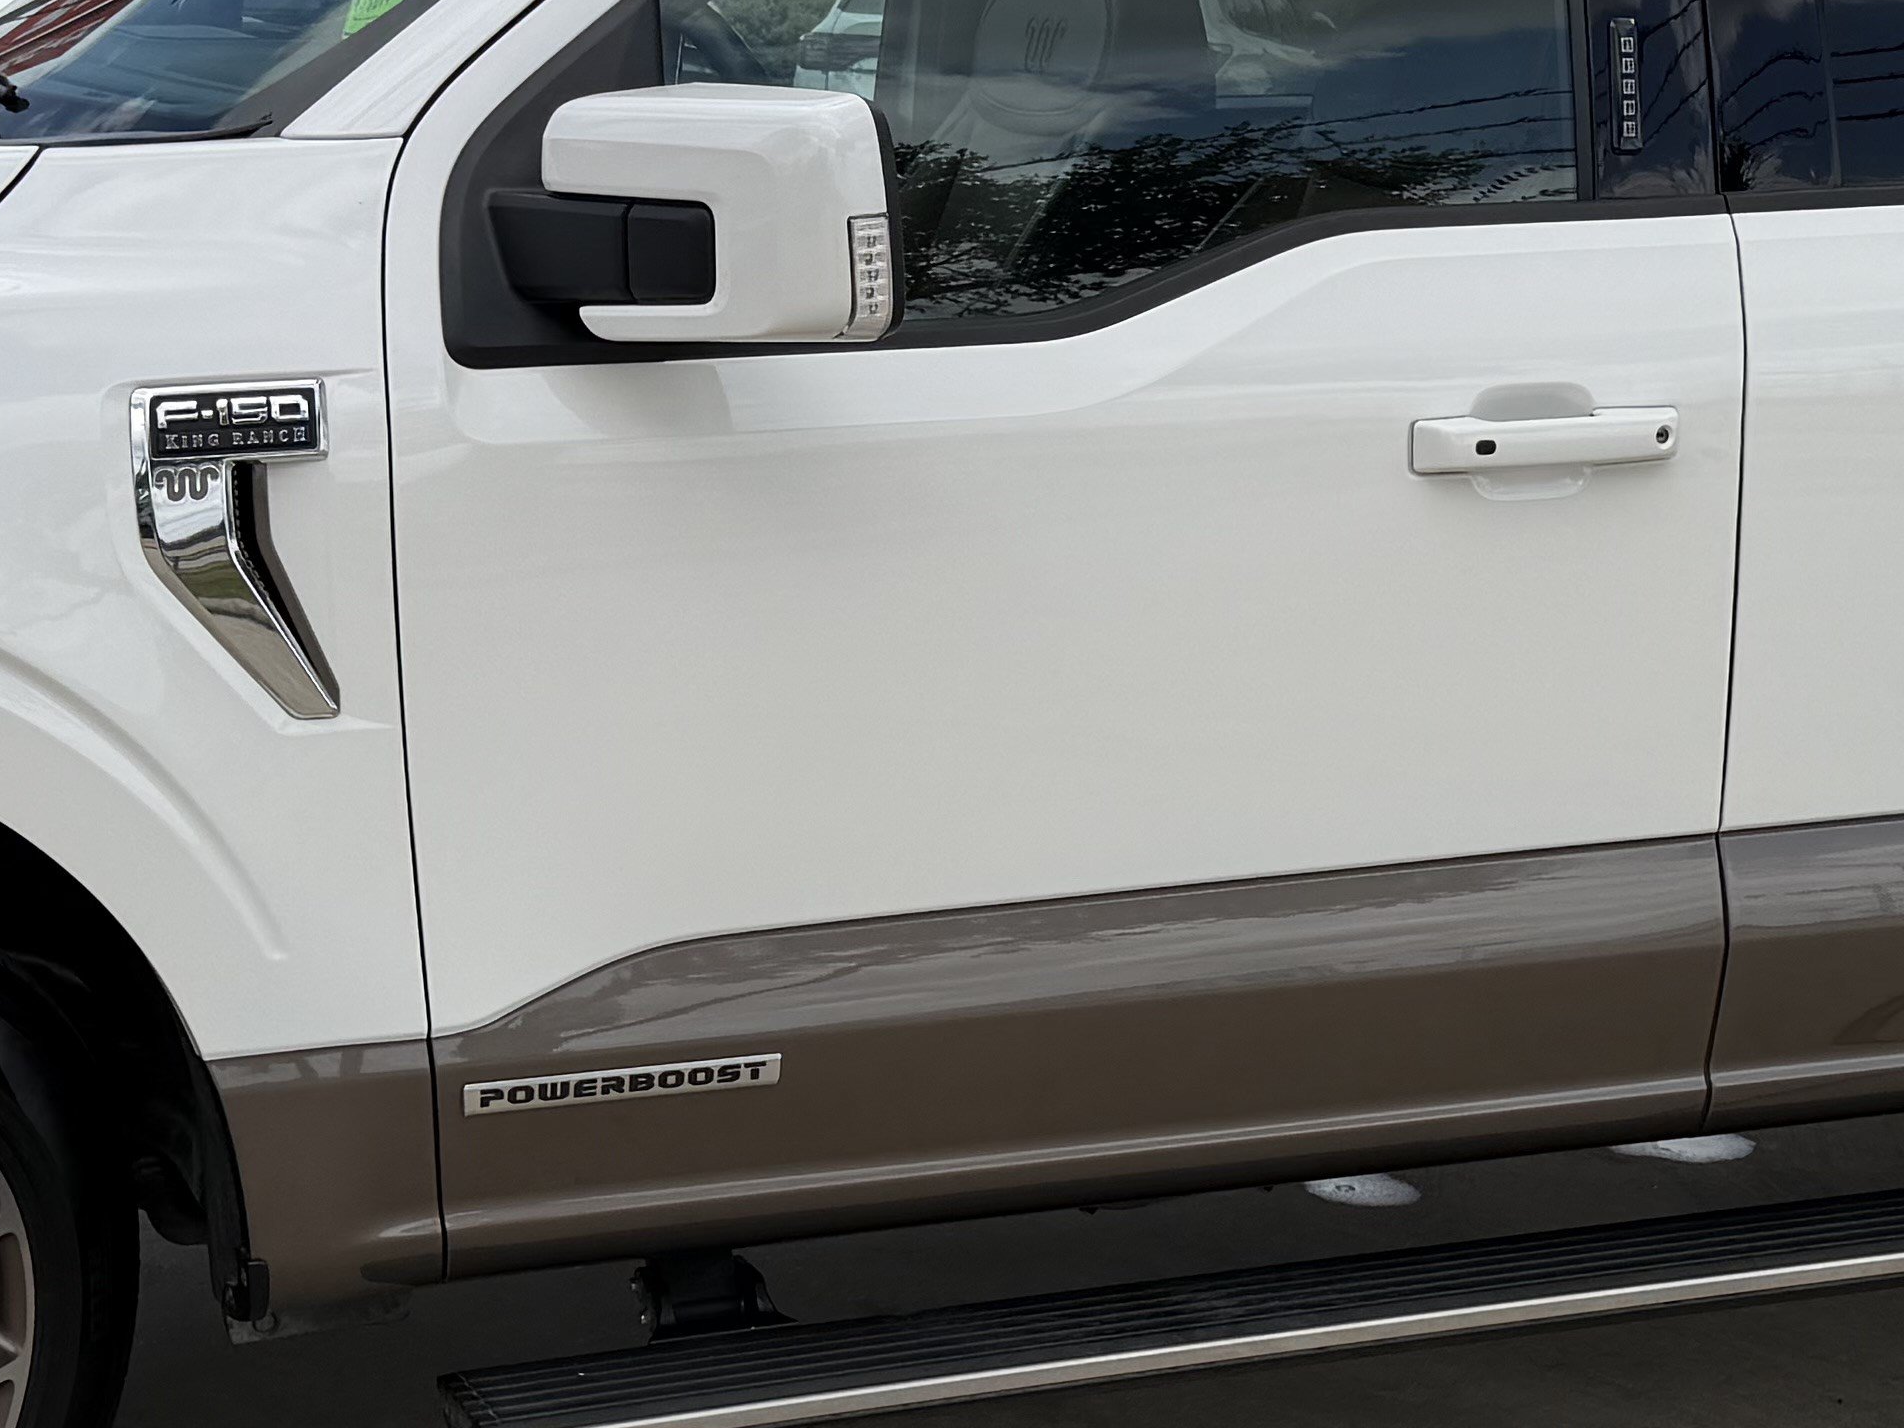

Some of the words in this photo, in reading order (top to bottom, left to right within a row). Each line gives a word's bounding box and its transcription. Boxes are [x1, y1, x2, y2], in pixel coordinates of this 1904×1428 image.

[155, 394, 310, 430] F-150
[165, 433, 220, 450] KING
[231, 426, 306, 446] RANCH
[479, 1060, 768, 1109] POWERBOOST
